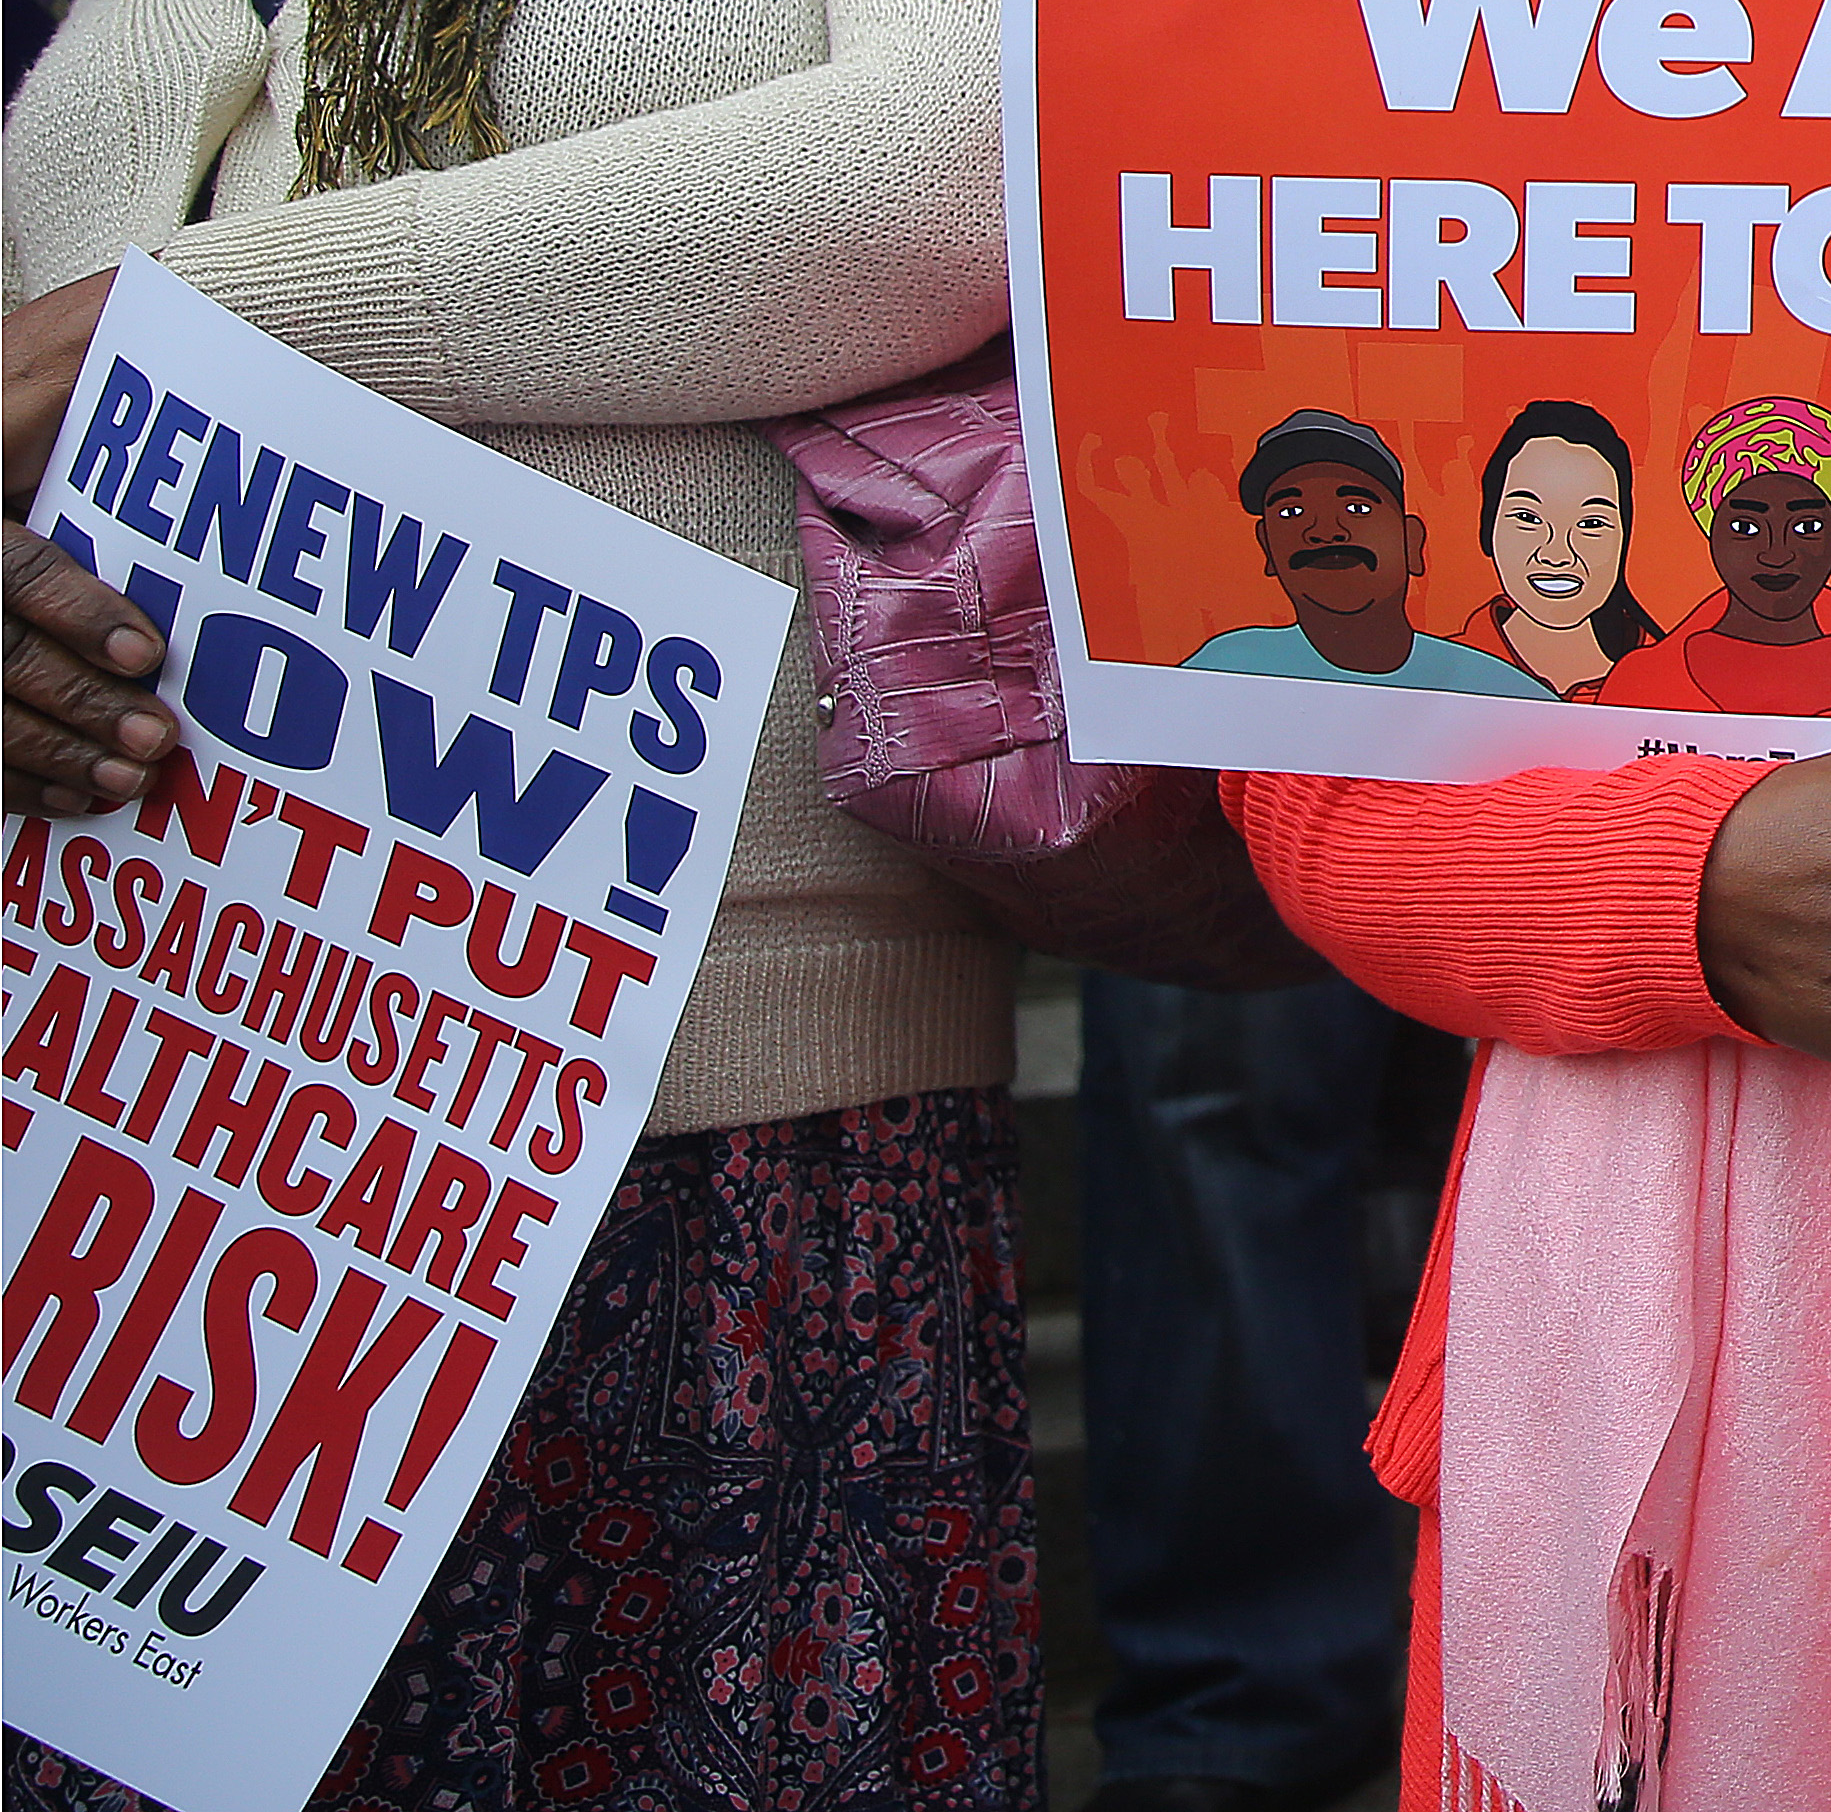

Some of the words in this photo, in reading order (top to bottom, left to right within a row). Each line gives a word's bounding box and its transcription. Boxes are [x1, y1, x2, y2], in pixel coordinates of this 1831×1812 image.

[1119, 172, 1637, 332] HERE
[68, 353, 470, 658] RENEW
[488, 558, 723, 775] TPS
[367, 839, 657, 1039] PUT
[3, 1135, 499, 1585] RISK!
[8, 1562, 127, 1658] Workers
[133, 1634, 204, 1690] East
